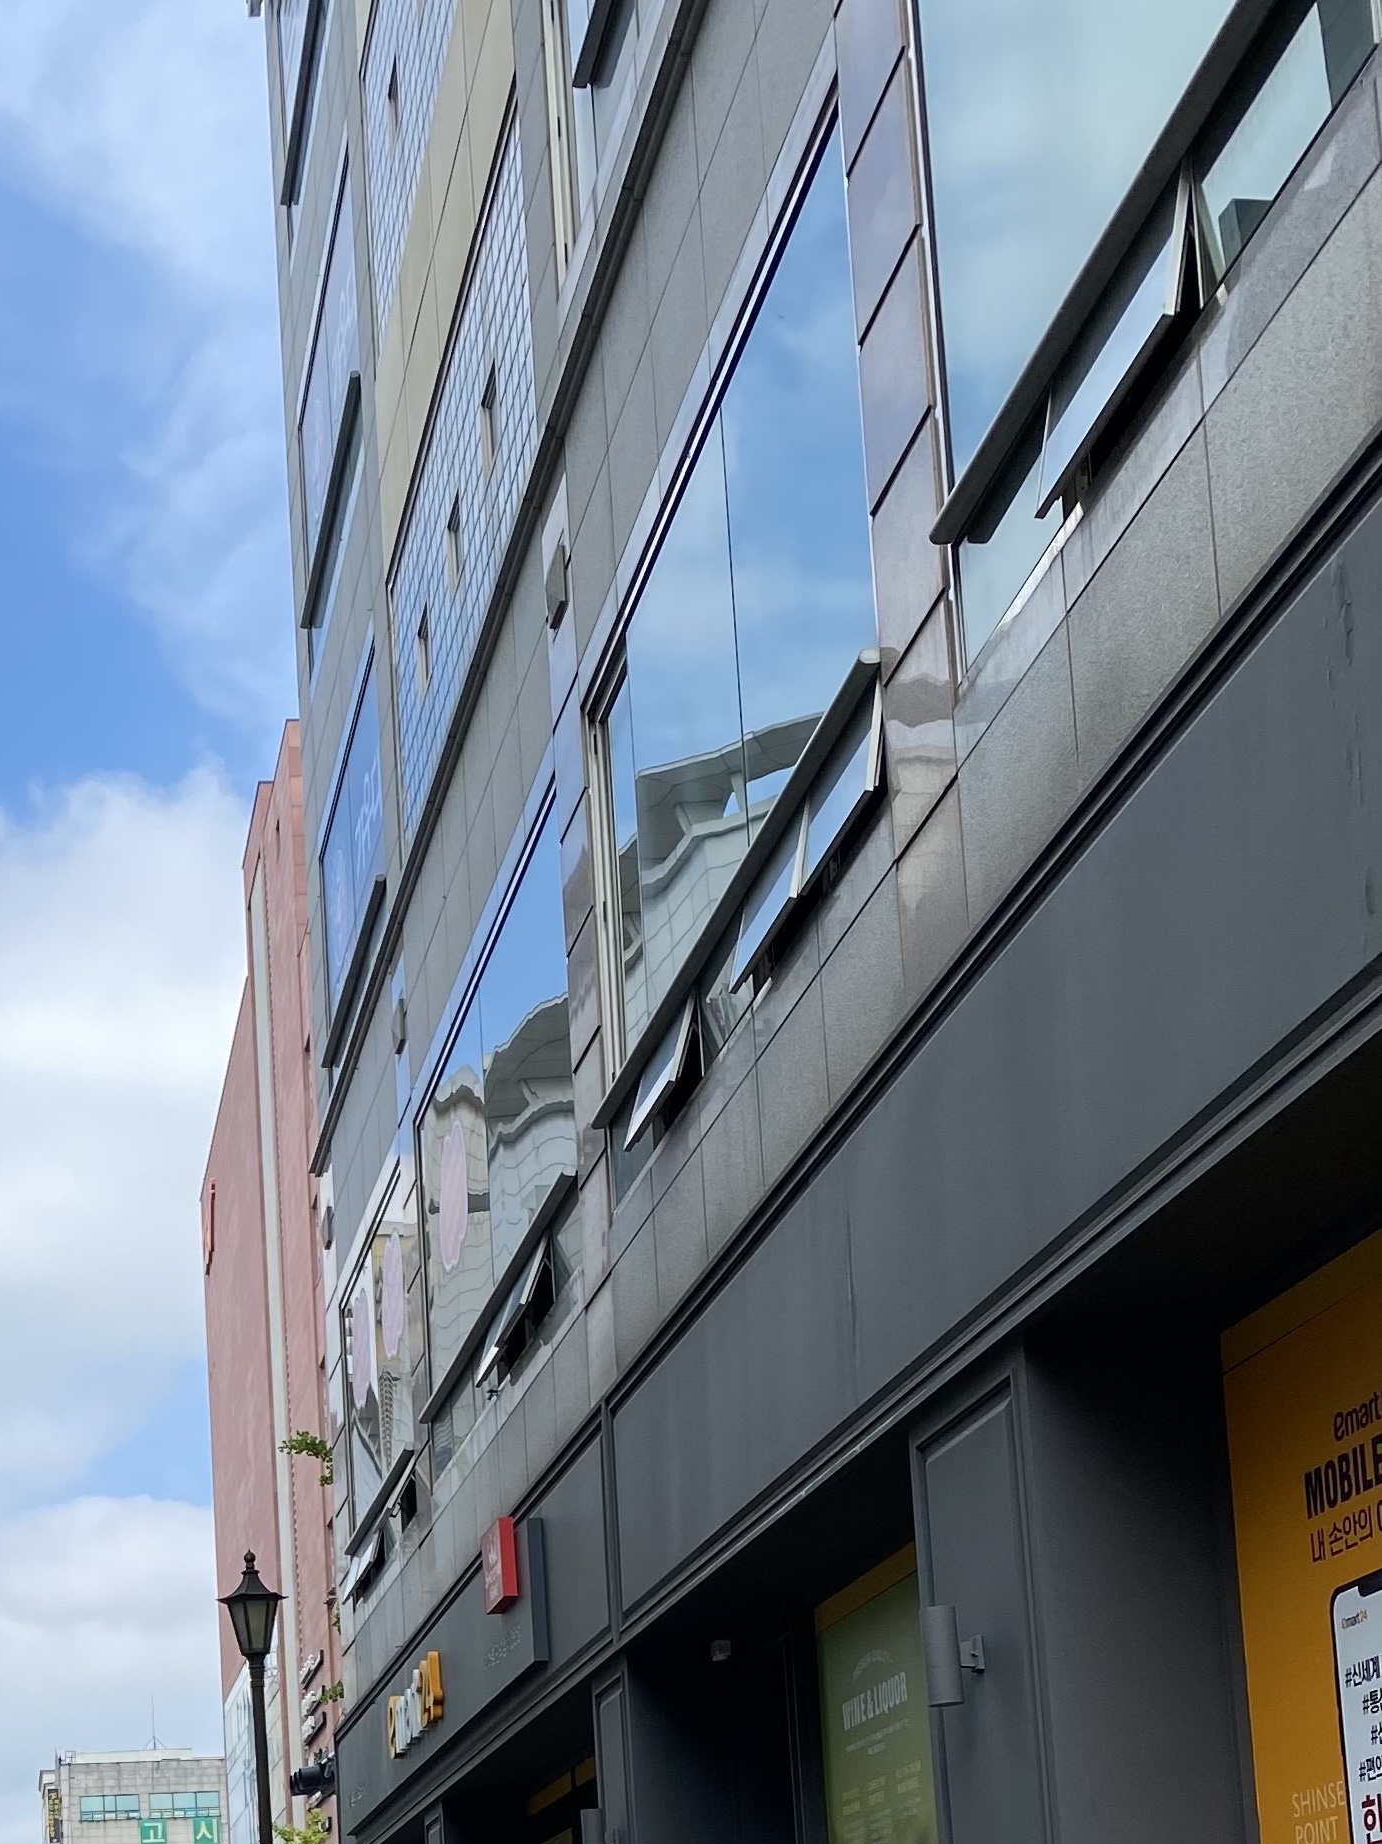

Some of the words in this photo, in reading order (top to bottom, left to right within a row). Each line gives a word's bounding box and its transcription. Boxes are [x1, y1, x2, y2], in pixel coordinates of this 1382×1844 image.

[1334, 1391, 1382, 1442] emart
[1304, 1432, 1382, 1520] MOBILE
[1309, 1527, 1326, 1563] 내
[1328, 1504, 1374, 1558] 손안의
[1344, 1654, 1380, 1688] #신세계
